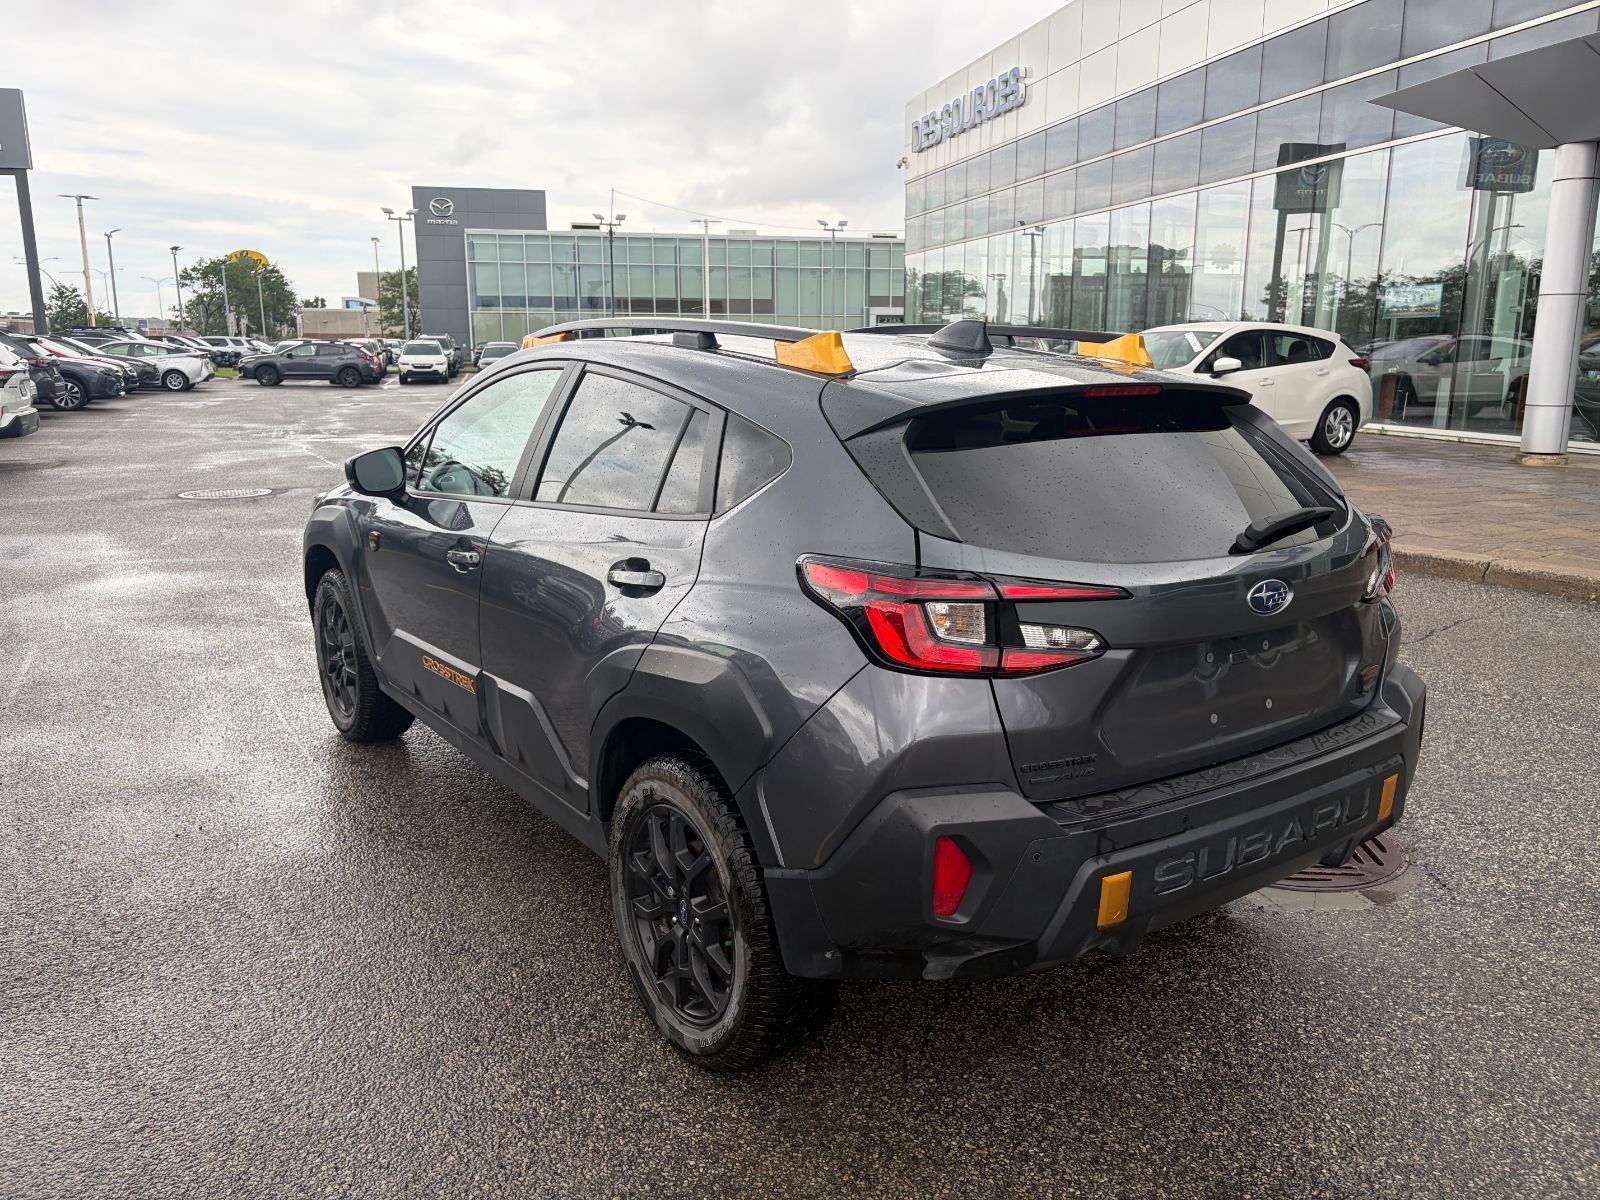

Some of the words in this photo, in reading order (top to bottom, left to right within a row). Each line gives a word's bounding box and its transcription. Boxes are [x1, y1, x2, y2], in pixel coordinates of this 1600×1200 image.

[912, 111, 942, 153] DES
[941, 66, 1027, 139] SOURCES
[422, 655, 476, 694] CROSSTREK
[1021, 754, 1097, 772] CROSSTREK
[1153, 786, 1371, 895] SUBARU
